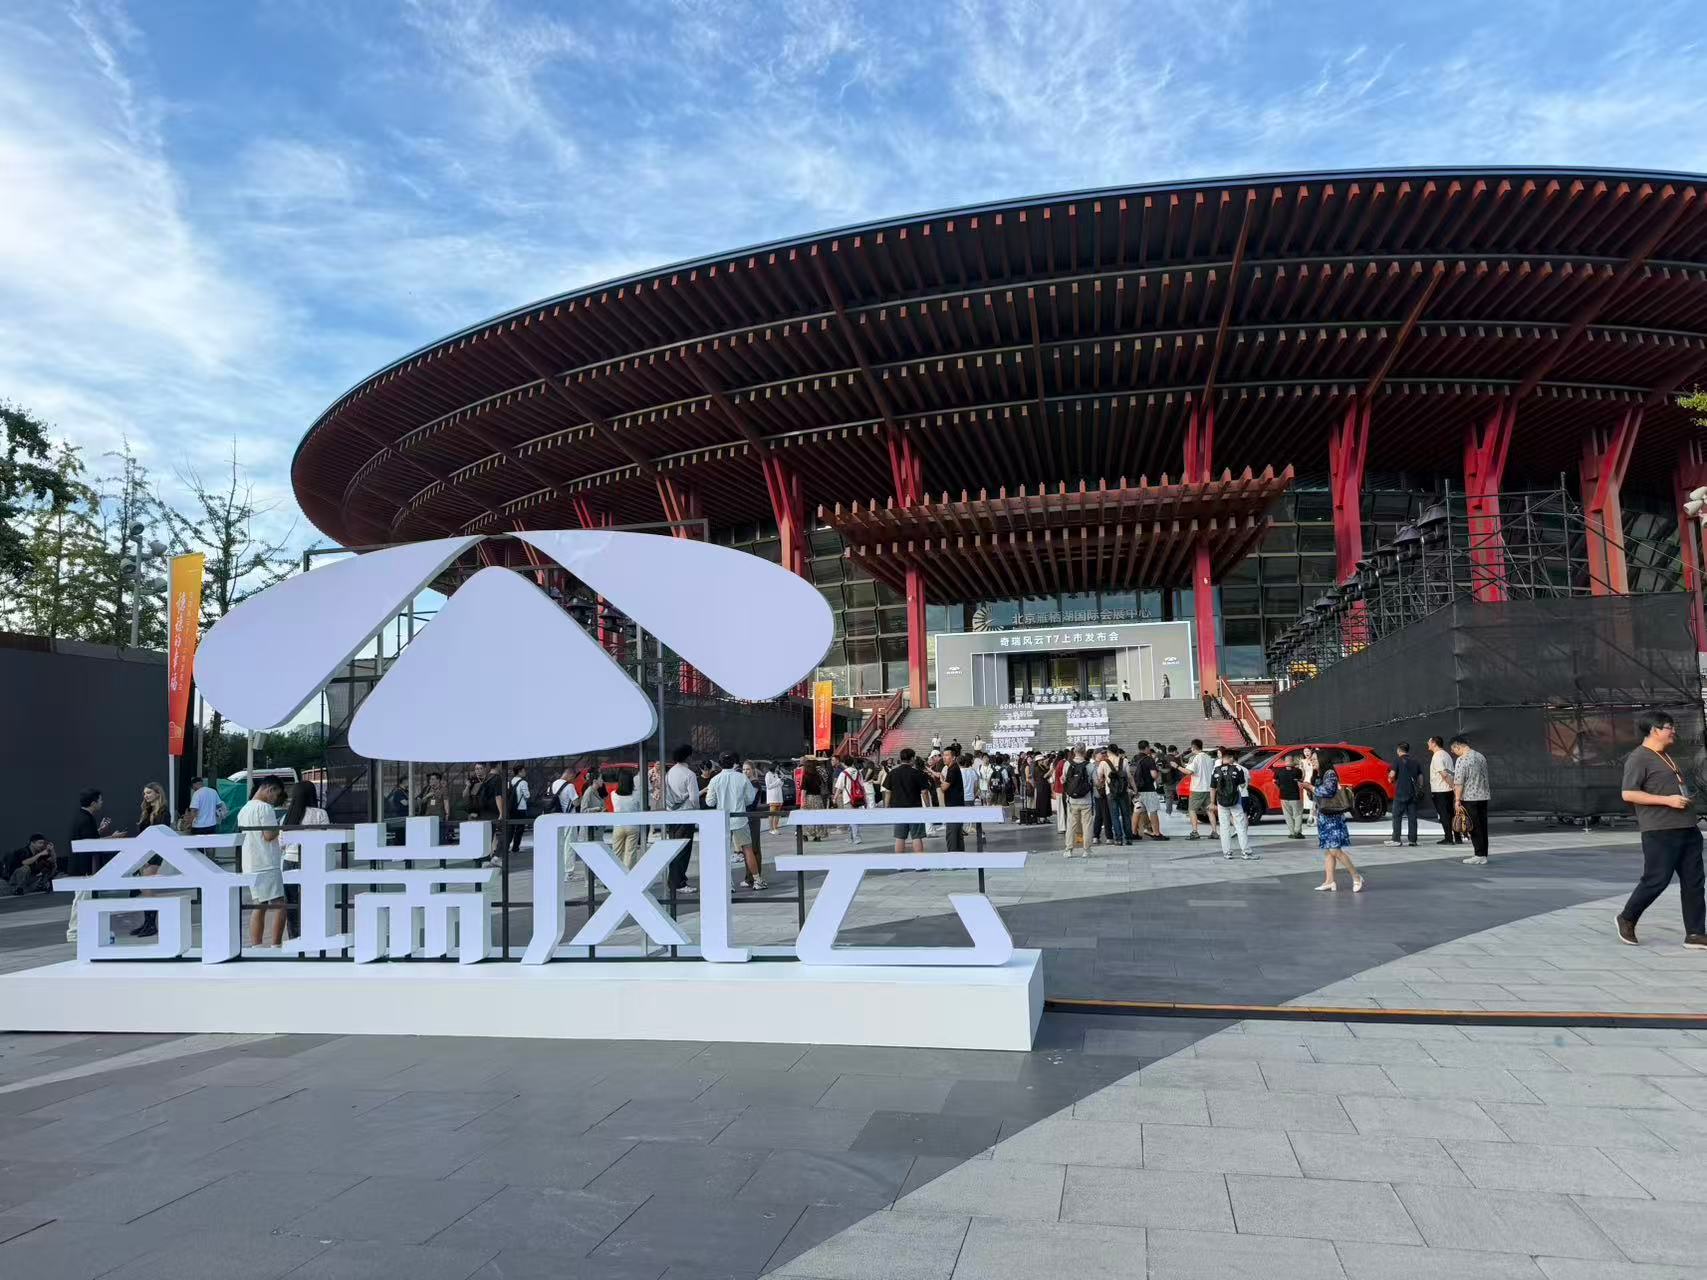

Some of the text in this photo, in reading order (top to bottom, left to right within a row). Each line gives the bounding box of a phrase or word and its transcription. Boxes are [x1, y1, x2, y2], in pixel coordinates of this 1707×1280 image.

[1012, 607, 1152, 625] 北京雁栖湖国际会展中心
[1000, 631, 1119, 647] 奇瑞风云T7上市发布会
[53, 805, 1027, 967] 奇瑞风云
